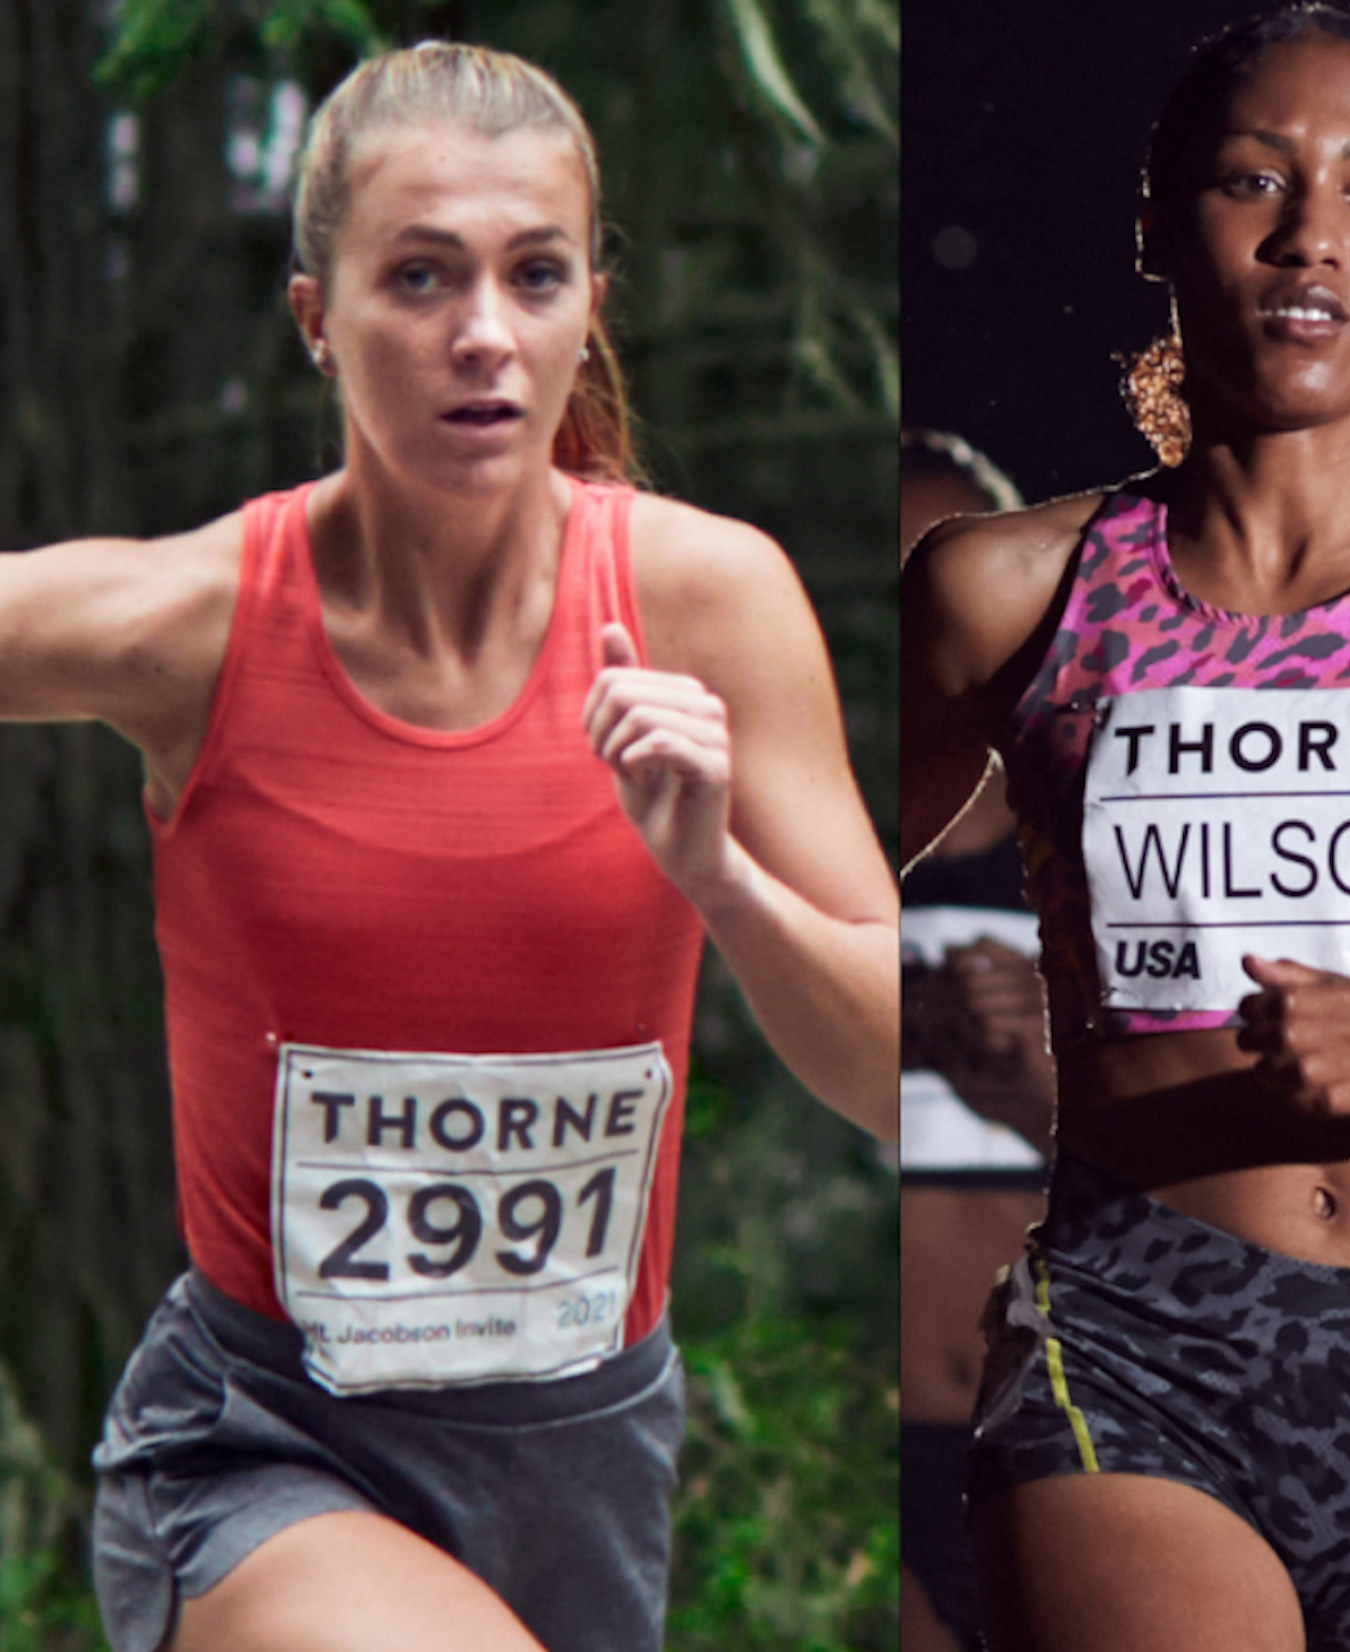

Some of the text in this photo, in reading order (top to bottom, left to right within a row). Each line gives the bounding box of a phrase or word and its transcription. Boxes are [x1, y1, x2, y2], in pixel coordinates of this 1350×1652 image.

[1114, 940, 1201, 980] USA
[311, 1089, 645, 1152] THORNE
[318, 1166, 617, 1281] 2991
[557, 1290, 617, 1329] 2021
[337, 1321, 451, 1344] Jacobson
[455, 1317, 517, 1339] Invite
